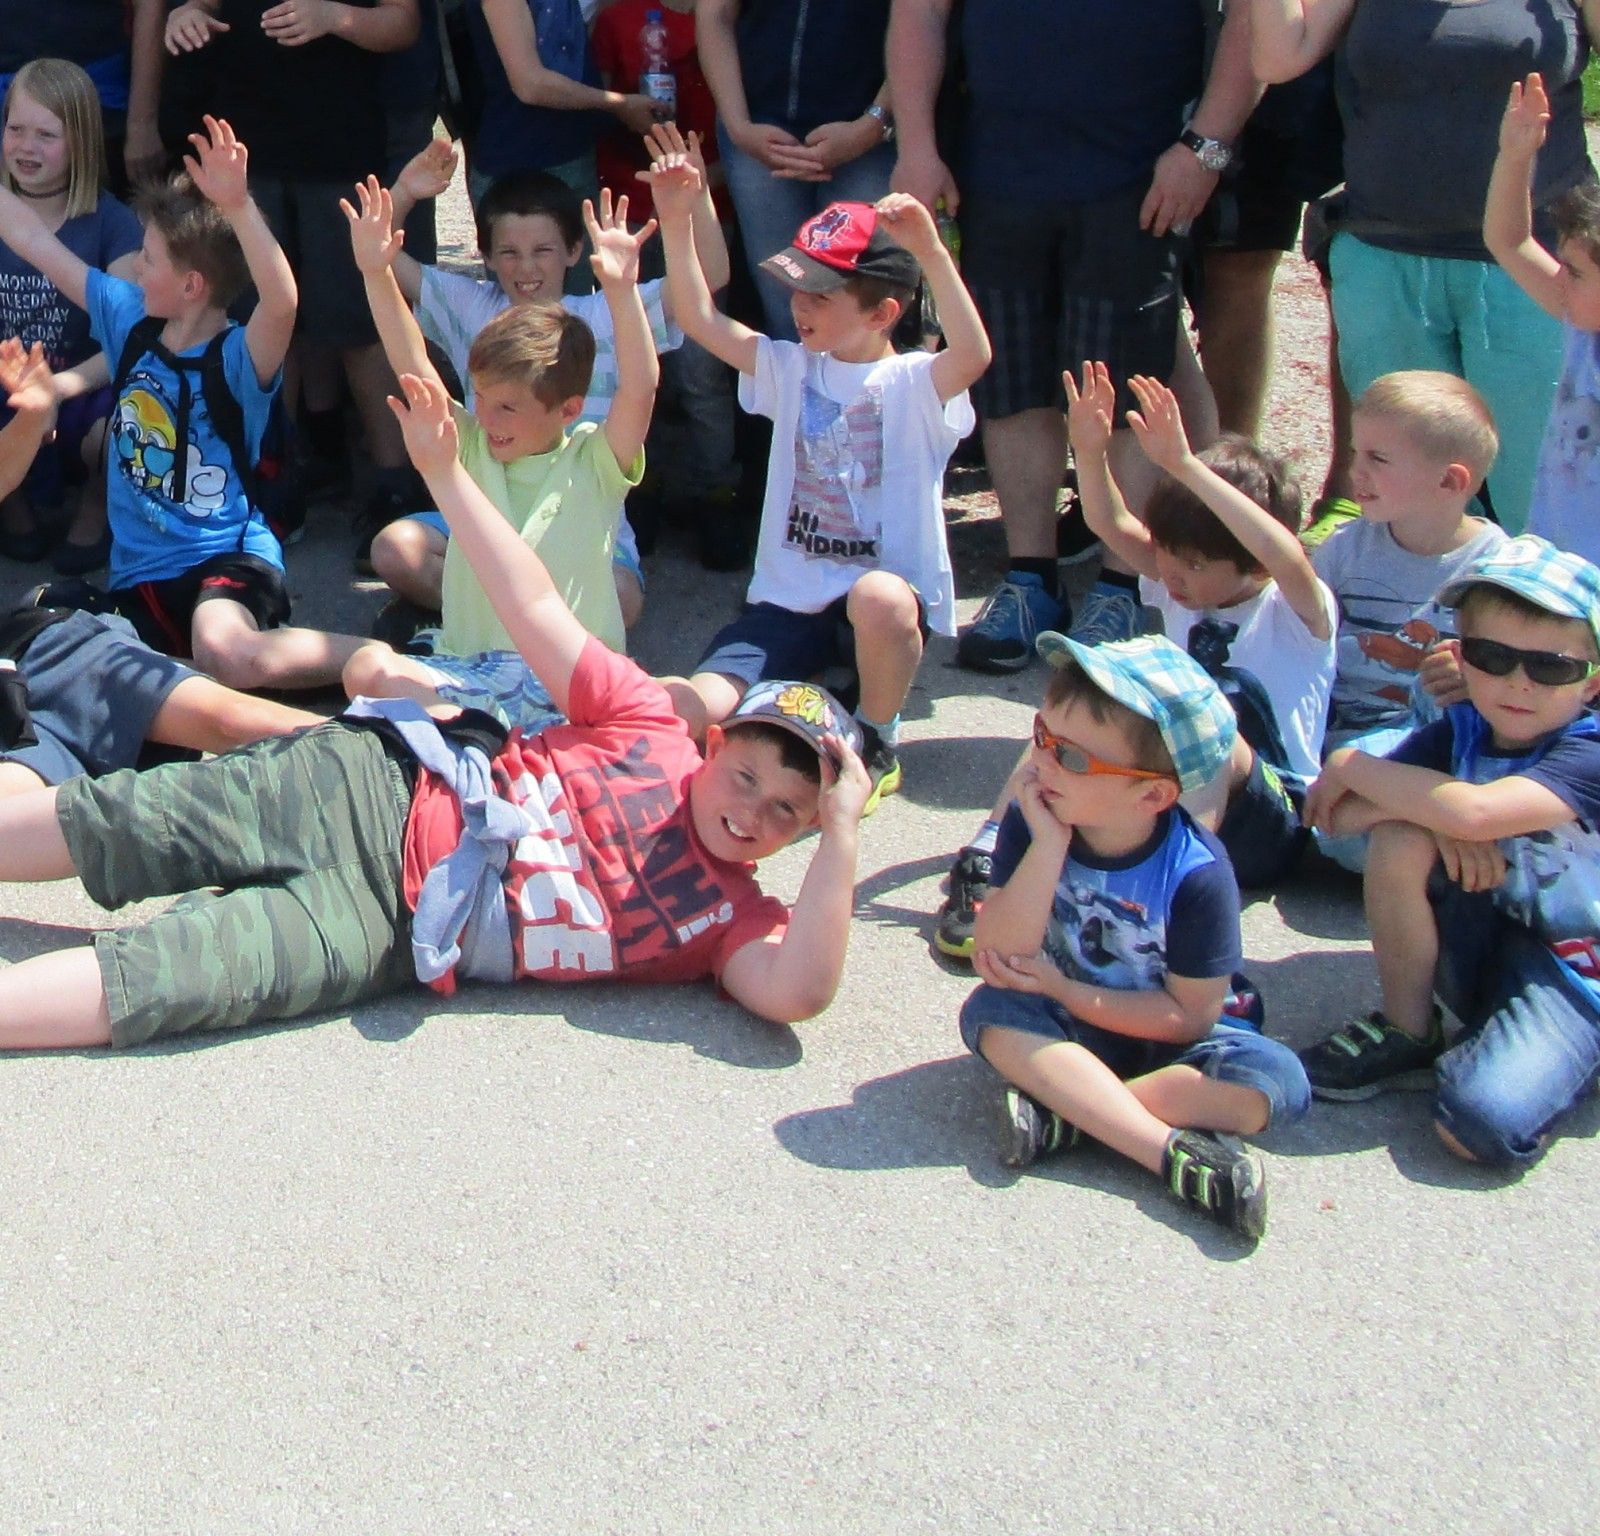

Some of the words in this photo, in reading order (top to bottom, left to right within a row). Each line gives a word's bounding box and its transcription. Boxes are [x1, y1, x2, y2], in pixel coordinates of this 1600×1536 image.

[0, 291, 58, 309] TUESDAY
[510, 771, 615, 973] NICE
[602, 735, 735, 946] YEAH!
